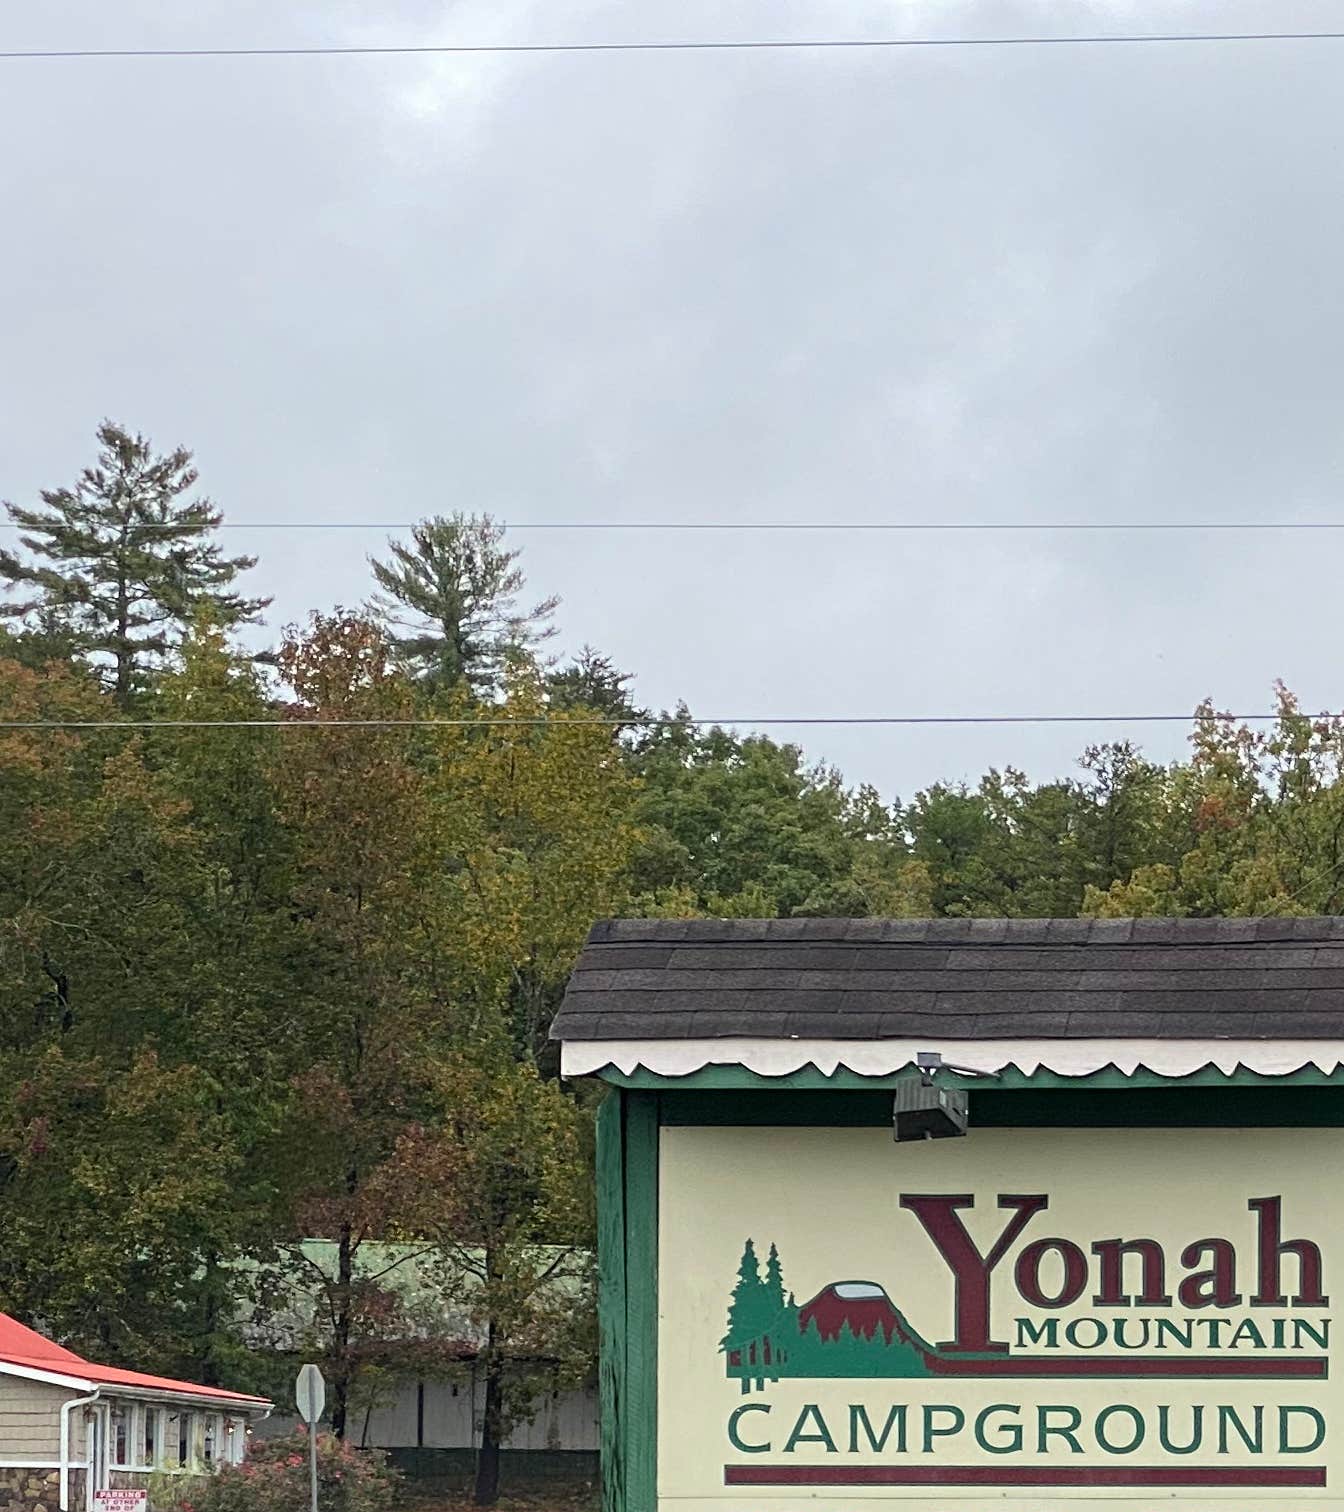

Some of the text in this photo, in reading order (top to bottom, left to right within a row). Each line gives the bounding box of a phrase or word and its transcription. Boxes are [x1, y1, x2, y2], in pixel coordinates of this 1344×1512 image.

[899, 1193, 1329, 1354] Yonah
[1014, 1317, 1332, 1350] MOUNTAIN
[727, 1403, 1326, 1455] CAMPGROUND
